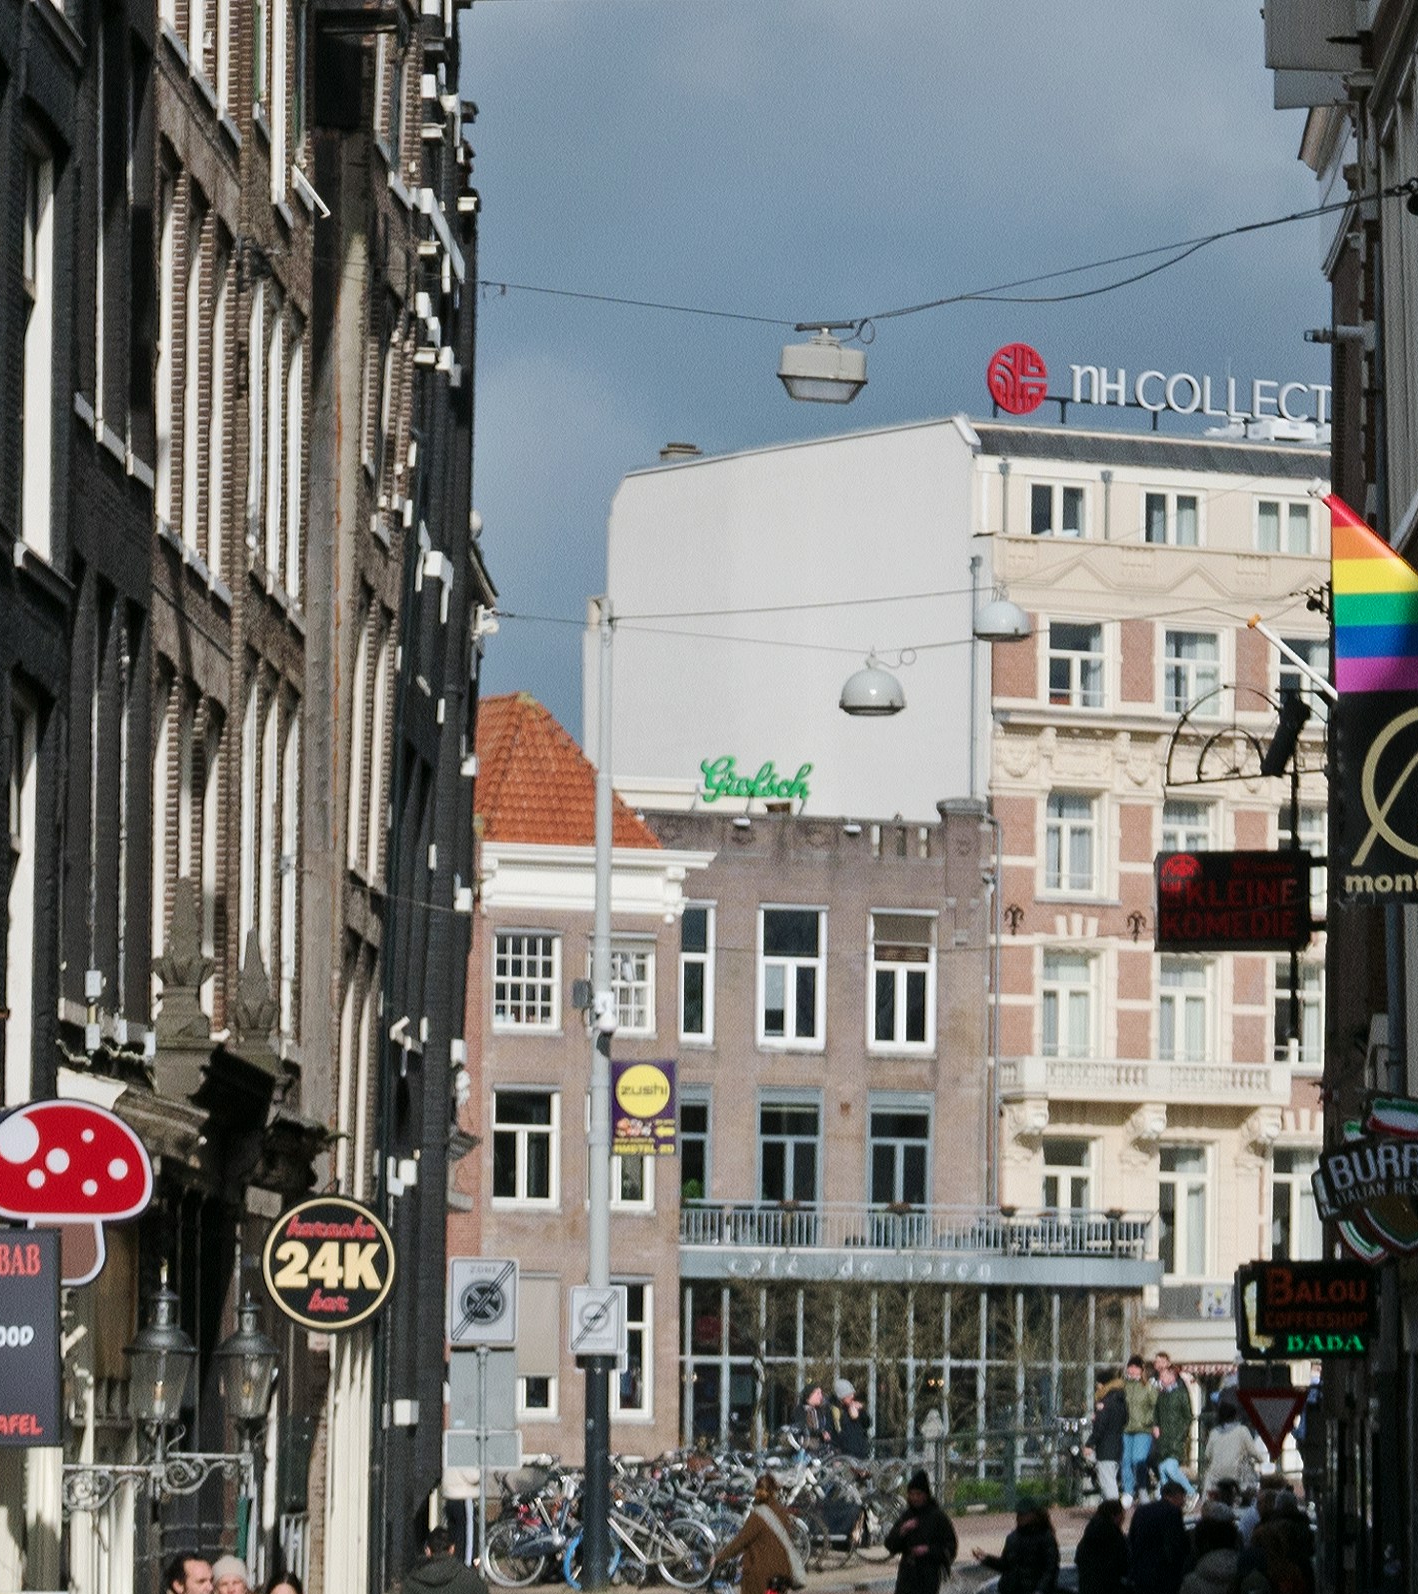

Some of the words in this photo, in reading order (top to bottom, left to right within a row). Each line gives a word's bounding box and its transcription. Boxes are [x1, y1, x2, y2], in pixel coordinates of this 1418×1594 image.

[700, 755, 812, 803] Grolsch
[1185, 878, 1298, 906] KLEINE
[1161, 911, 1297, 939] KOMEDIE
[621, 1082, 668, 1096] zushi
[1335, 1182, 1386, 1204] ITALIAN
[274, 1241, 382, 1290] 24K
[840, 1255, 875, 1275] de
[308, 1288, 349, 1312] bar
